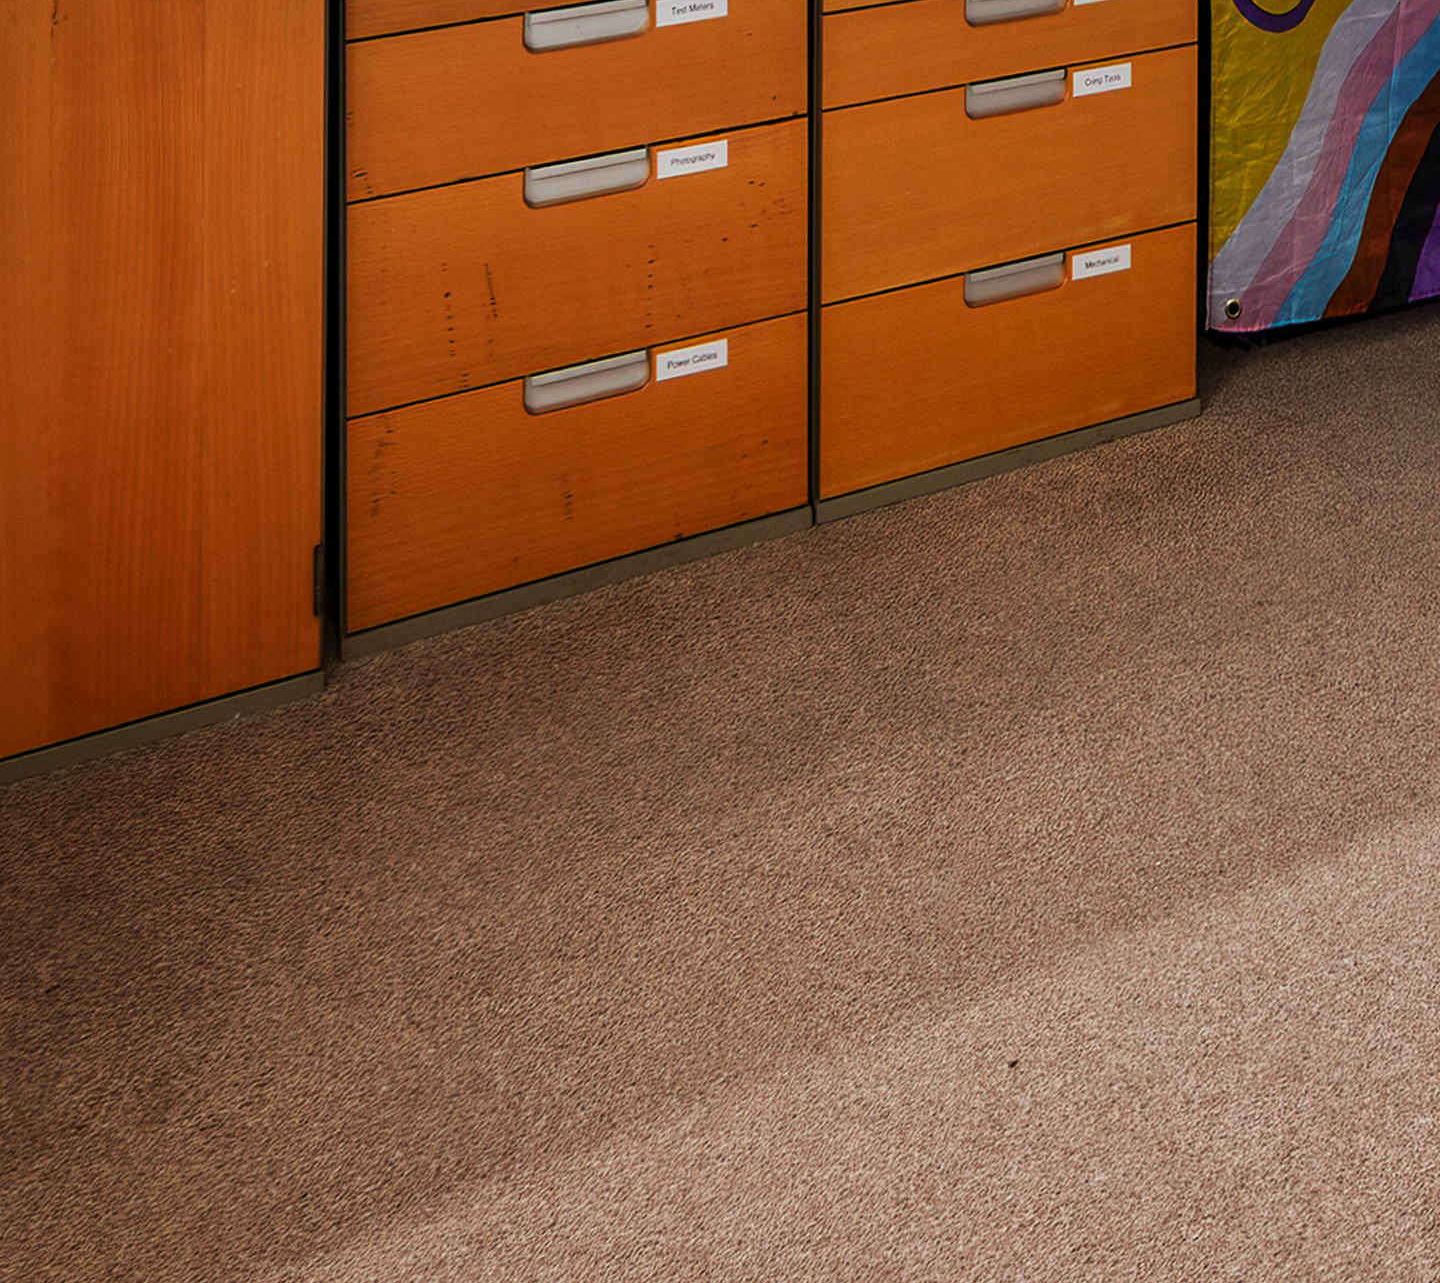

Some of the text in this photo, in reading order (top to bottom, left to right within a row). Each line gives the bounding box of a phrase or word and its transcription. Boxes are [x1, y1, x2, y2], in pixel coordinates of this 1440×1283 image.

[671, 2, 714, 16] Test Meters
[670, 152, 716, 167] Photography
[667, 352, 718, 370] Power Cables
